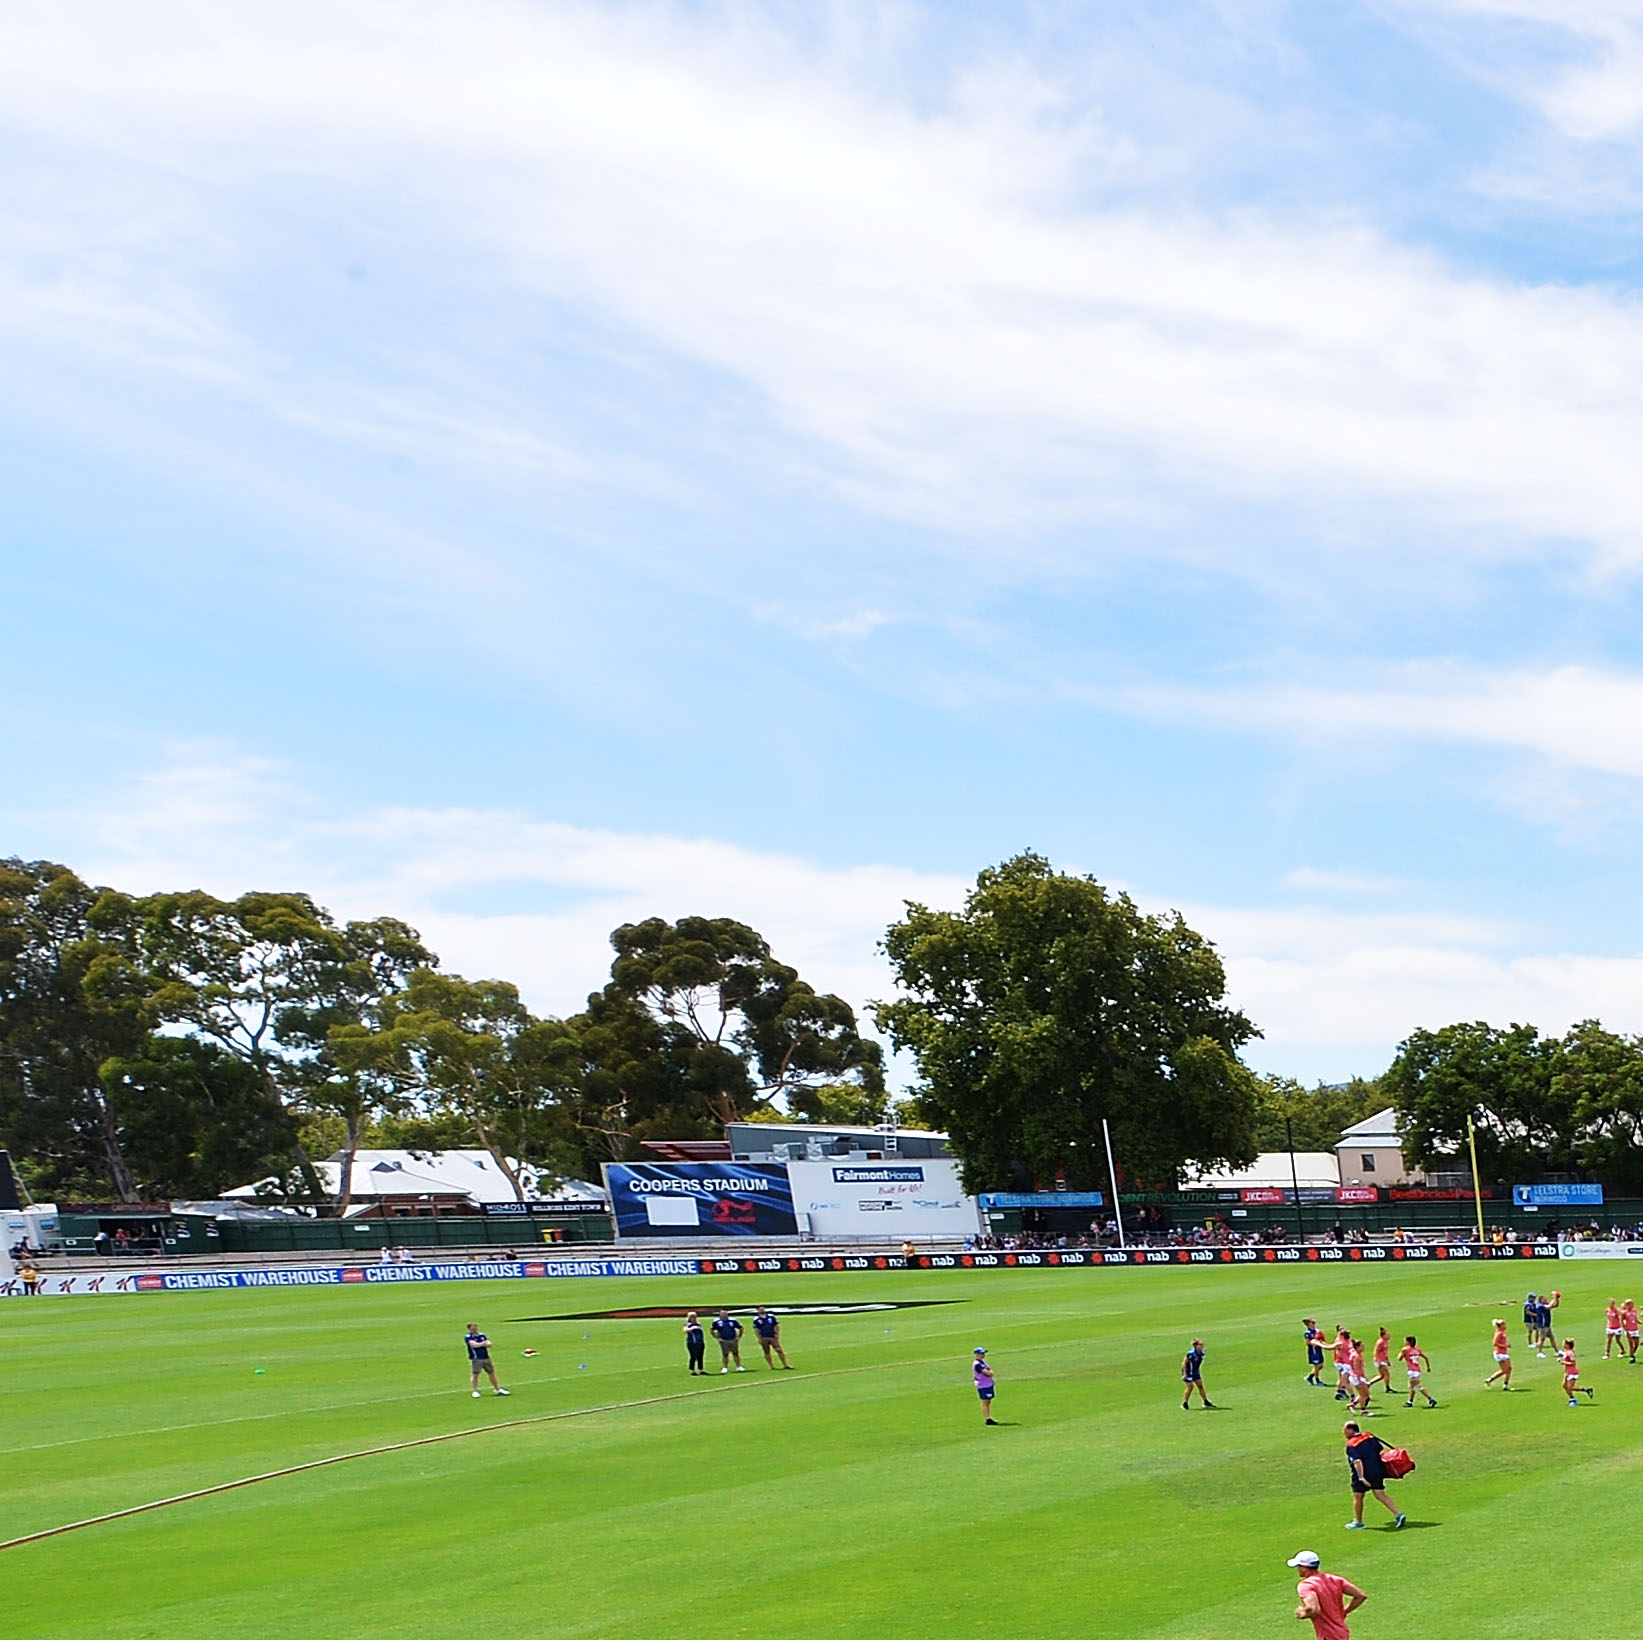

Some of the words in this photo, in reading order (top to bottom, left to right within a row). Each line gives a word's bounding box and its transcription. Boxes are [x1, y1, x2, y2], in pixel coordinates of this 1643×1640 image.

[629, 1179, 699, 1192] COOPERS
[703, 1179, 768, 1191] STADIUM
[1534, 1186, 1570, 1195] TELSTRA
[1571, 1186, 1598, 1195] STORE
[1191, 1250, 1213, 1261] nab
[1234, 1250, 1257, 1260] nab
[1277, 1249, 1300, 1260] nab
[1320, 1248, 1342, 1259] nab
[1363, 1247, 1385, 1258] nab
[1406, 1247, 1429, 1257] nab
[1449, 1246, 1471, 1257] nab
[1535, 1245, 1556, 1255] nab
[932, 1255, 955, 1266] nab
[975, 1254, 998, 1265] nab
[1018, 1253, 1041, 1264] nab
[1061, 1252, 1084, 1263] nab
[1104, 1251, 1127, 1262] nab
[1147, 1251, 1169, 1262] nab
[548, 1261, 608, 1276] CHEMIST
[611, 1260, 697, 1275] WAREHOUSE
[716, 1260, 738, 1271] nab
[759, 1259, 781, 1270] nab
[801, 1258, 824, 1269] nab
[846, 1257, 868, 1268] nab
[366, 1266, 432, 1282] CHEMIST
[435, 1263, 522, 1279] WAREHOUSE
[165, 1273, 239, 1288] CHEMIST
[242, 1270, 339, 1286] WAREHOUSE
